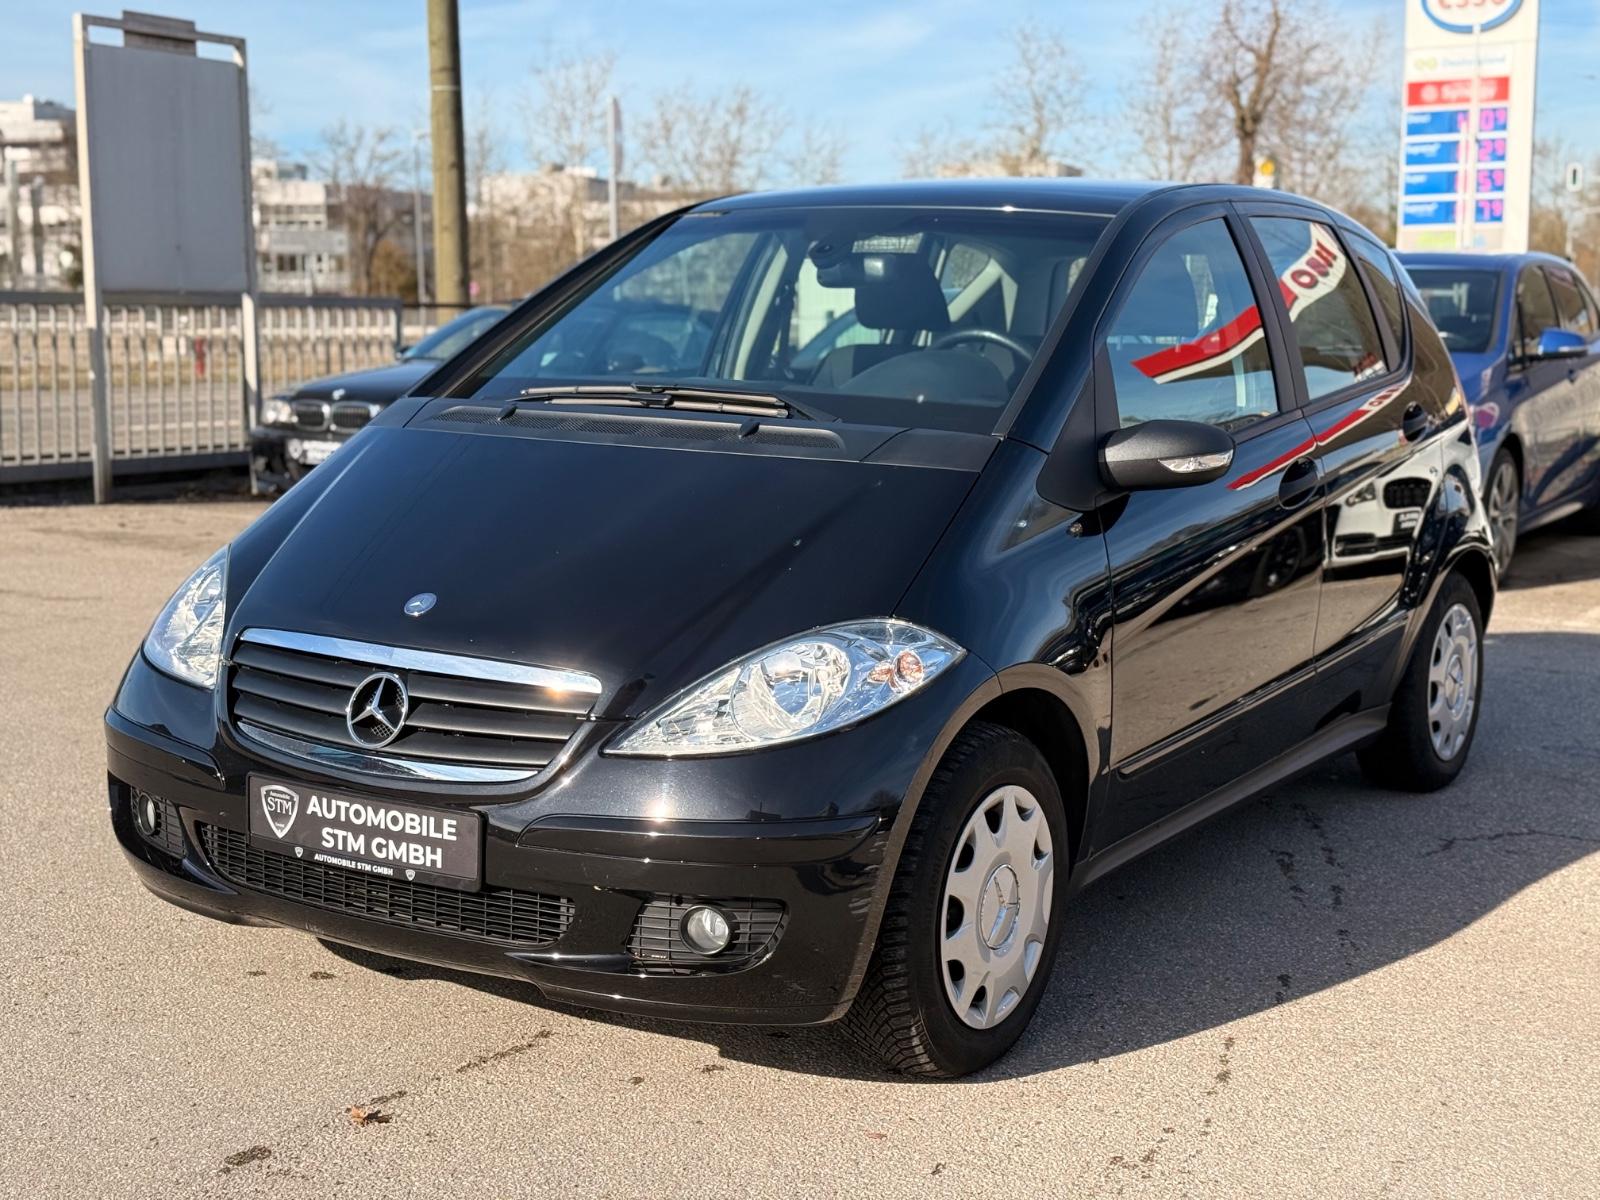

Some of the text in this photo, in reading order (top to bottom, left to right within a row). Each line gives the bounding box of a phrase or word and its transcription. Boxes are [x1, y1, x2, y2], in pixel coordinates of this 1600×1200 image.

[267, 796, 292, 816] STM
[306, 795, 457, 841] AUTOMOBILE
[321, 827, 442, 868] STM GMBH
[314, 853, 394, 876] AUTOMOBILE STM GMBH
